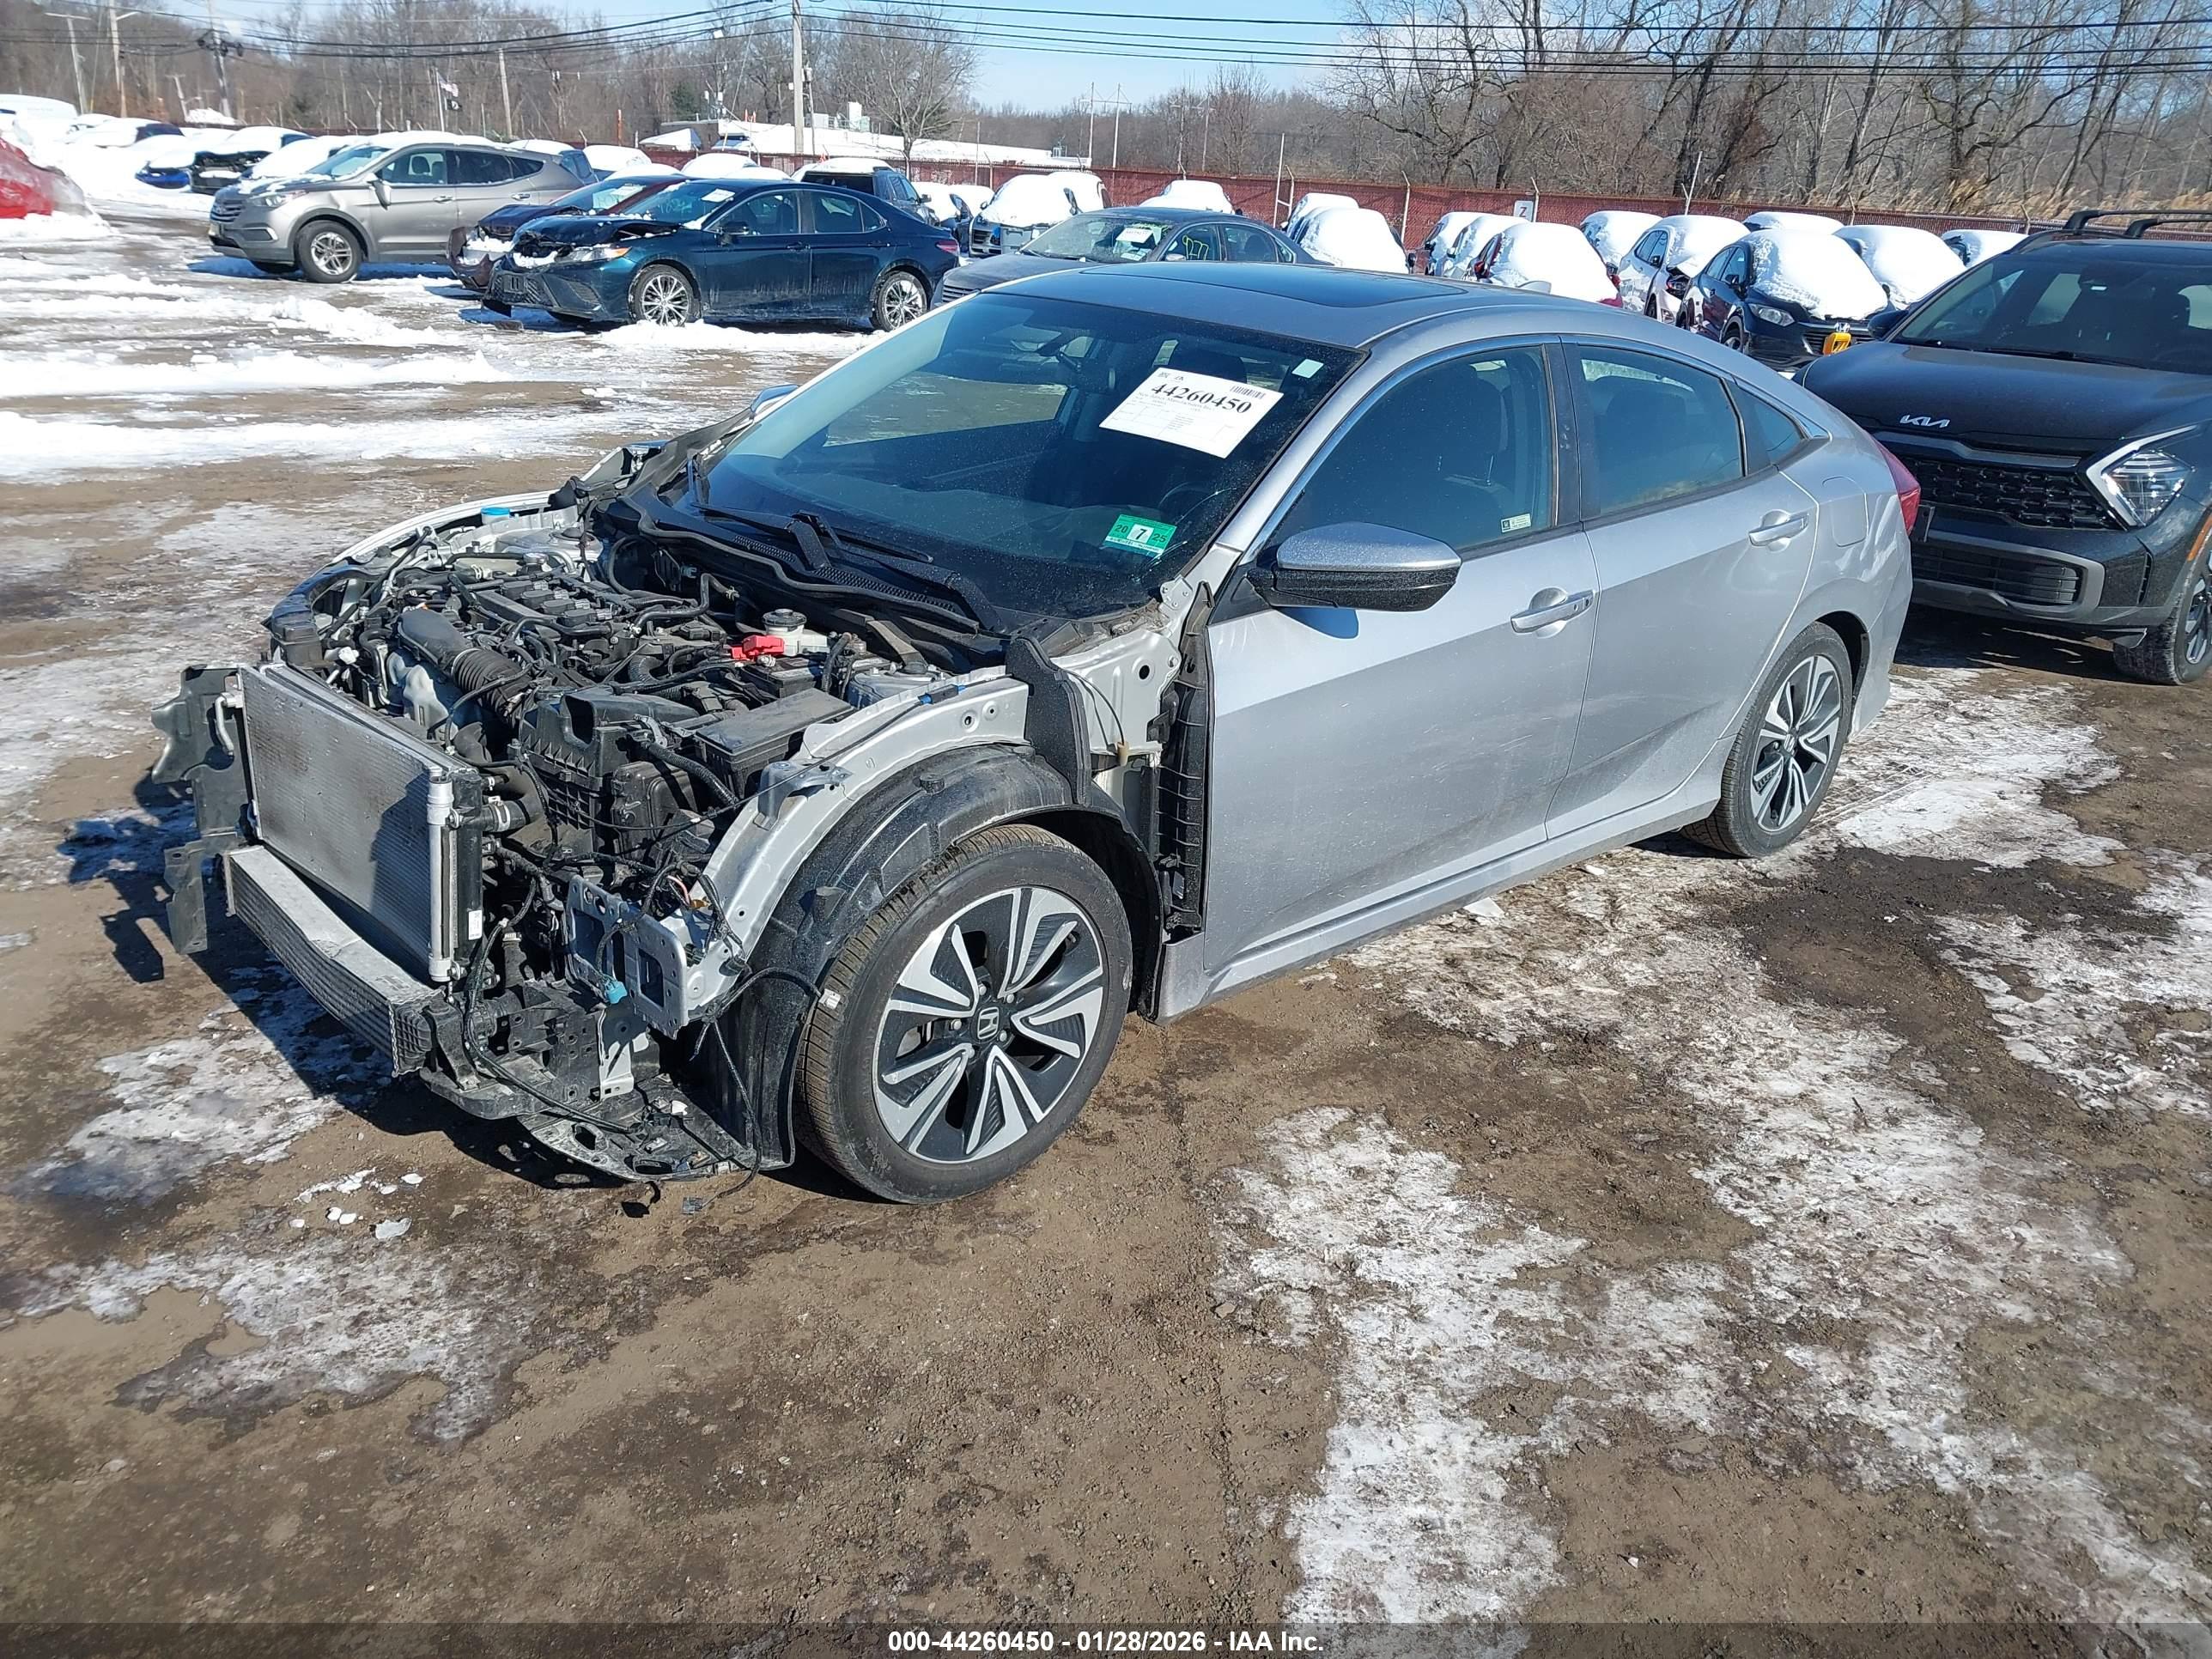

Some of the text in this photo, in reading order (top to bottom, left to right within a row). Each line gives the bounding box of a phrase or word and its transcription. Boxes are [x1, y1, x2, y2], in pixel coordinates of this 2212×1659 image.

[1519, 206, 1527, 218] Z
[1151, 383, 1253, 414] 44260450
[1115, 524, 1168, 543] 20 7 25
